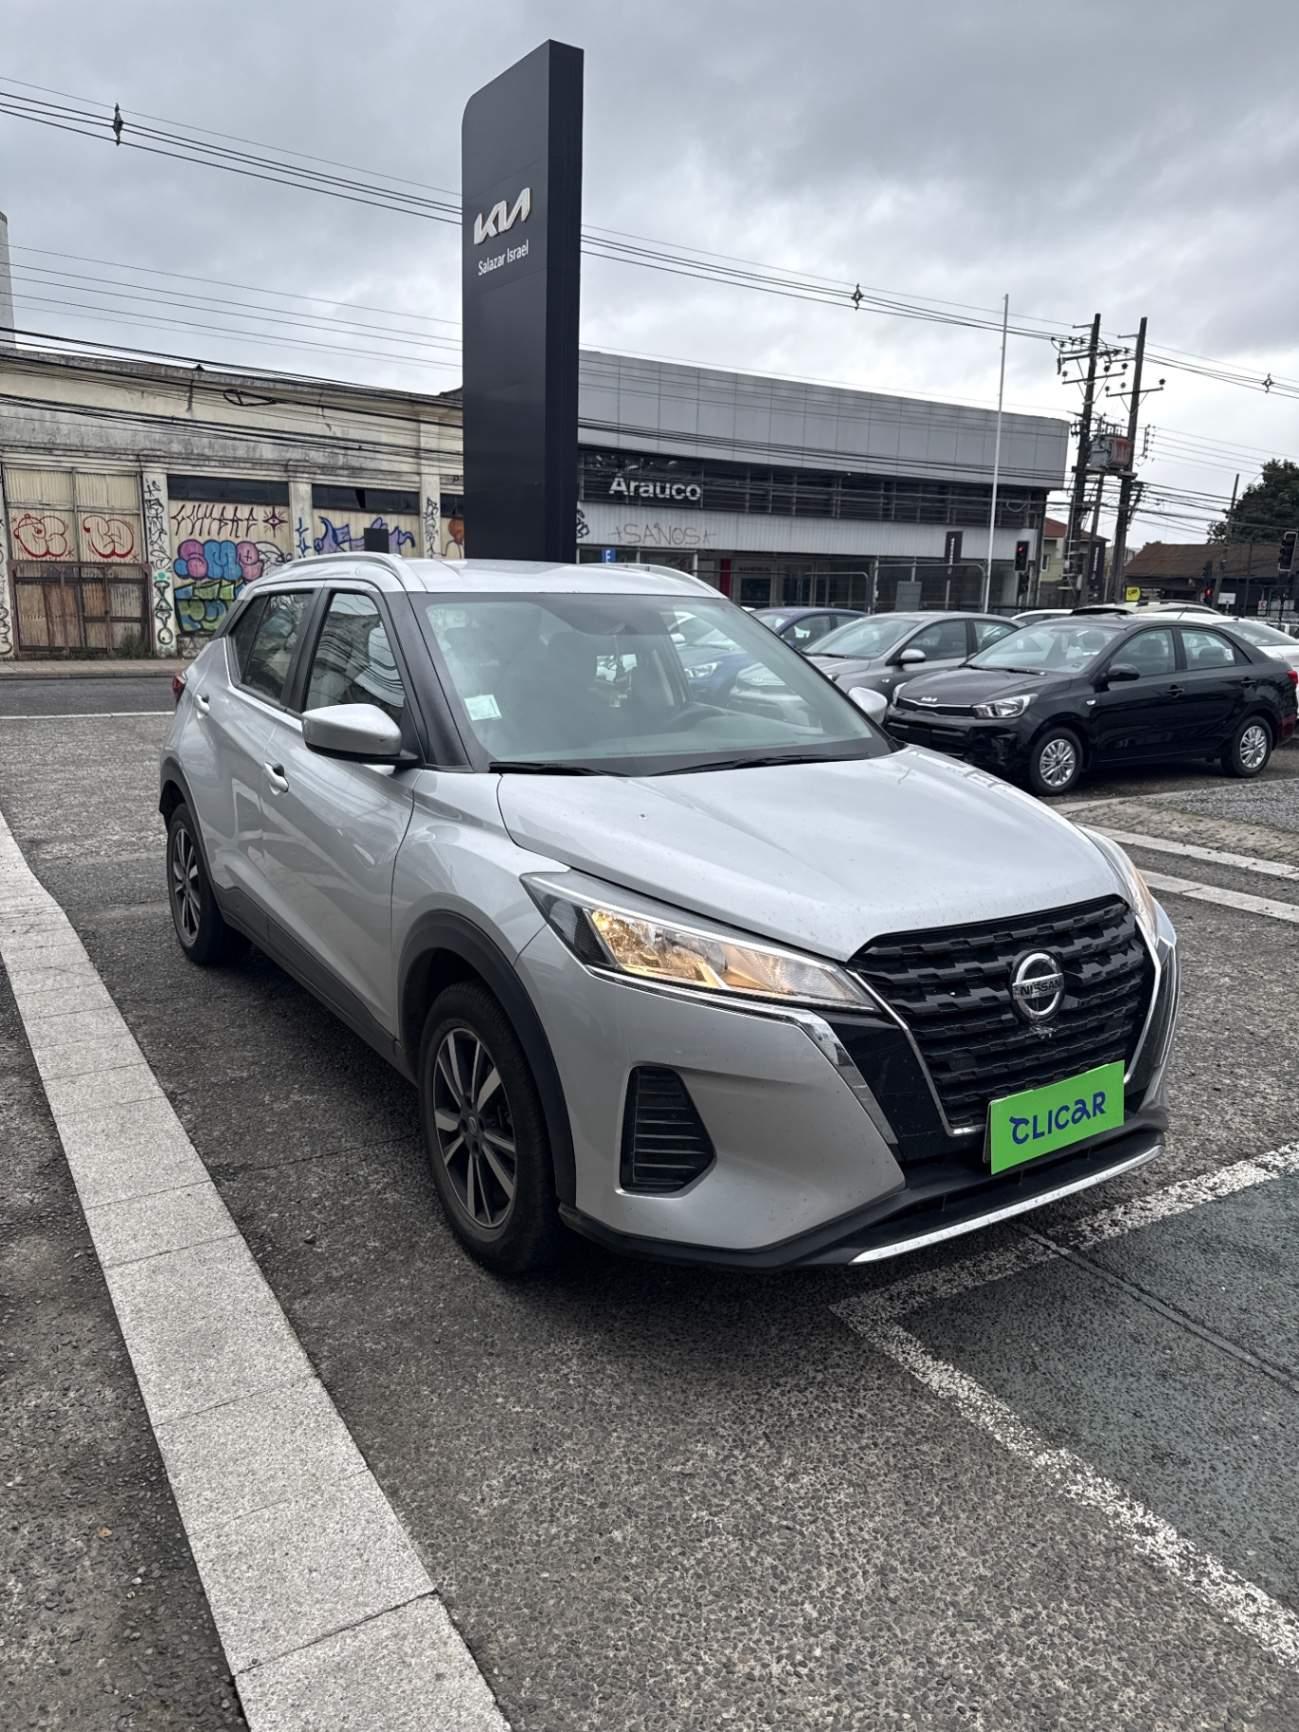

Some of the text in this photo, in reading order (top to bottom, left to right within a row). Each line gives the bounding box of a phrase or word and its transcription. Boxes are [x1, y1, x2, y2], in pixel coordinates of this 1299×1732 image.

[473, 187, 531, 244] KIA
[478, 239, 529, 276] Salazar Israel
[608, 476, 702, 502] Arauco
[1021, 978, 1060, 996] NISSAN
